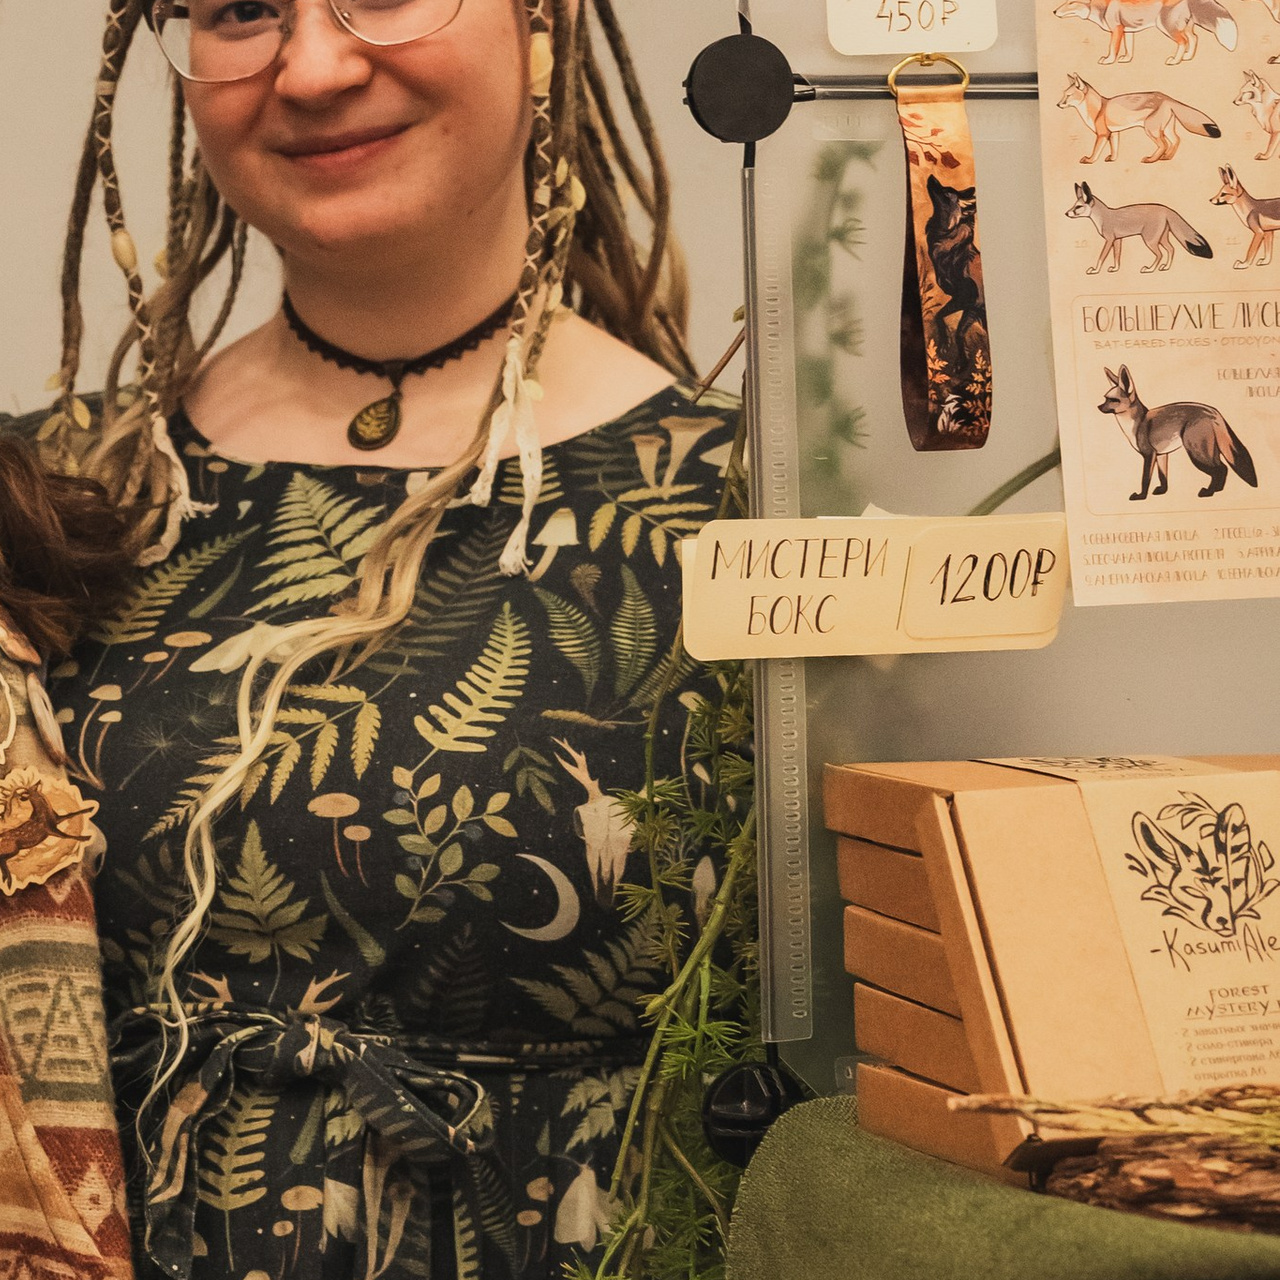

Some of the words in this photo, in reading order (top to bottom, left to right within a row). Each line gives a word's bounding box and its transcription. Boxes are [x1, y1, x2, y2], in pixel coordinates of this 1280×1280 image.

[1082, 303, 1225, 333] БОЛЬШЕУХИЕ
[1094, 338, 1166, 350] BAT-EARED
[1170, 338, 1211, 348] FOXES
[711, 538, 889, 580] МИСТЕРИ
[747, 594, 837, 635] БОКС
[1208, 983, 1269, 1003] FOREST
[1187, 1000, 1270, 1020] MYSTERY
